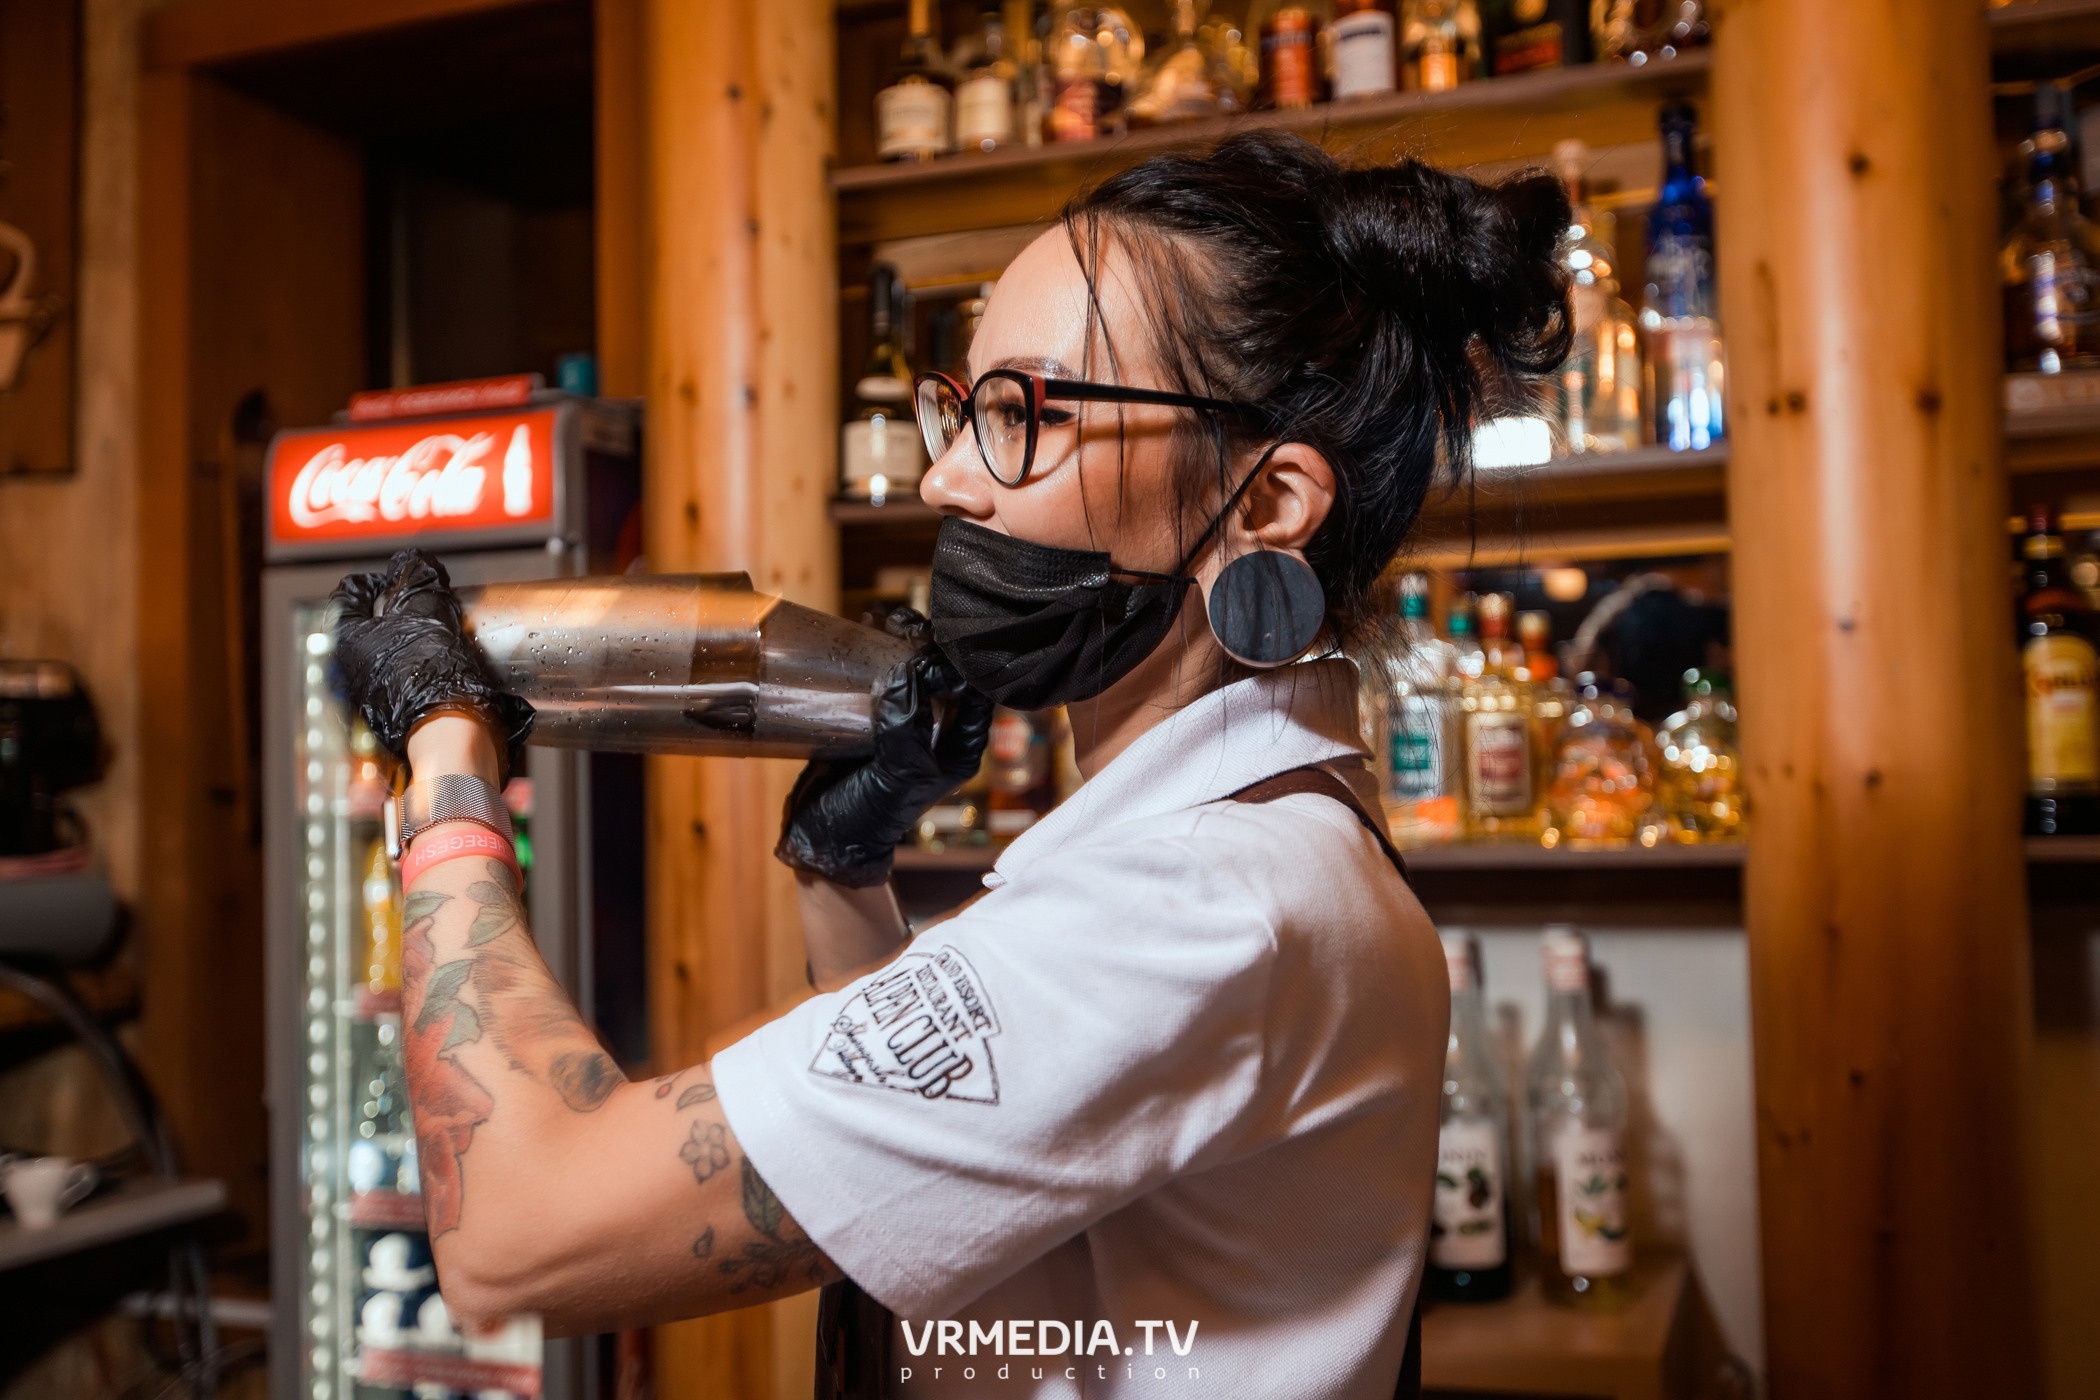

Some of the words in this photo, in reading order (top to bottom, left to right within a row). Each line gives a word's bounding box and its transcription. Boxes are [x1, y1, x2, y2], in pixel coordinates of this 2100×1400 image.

[414, 834, 509, 867] HEREGESH
[861, 966, 925, 1031] ALPEN
[915, 963, 974, 1042] RESTAURANT
[953, 974, 992, 1031] RESORT
[887, 1014, 974, 1100] CLUB
